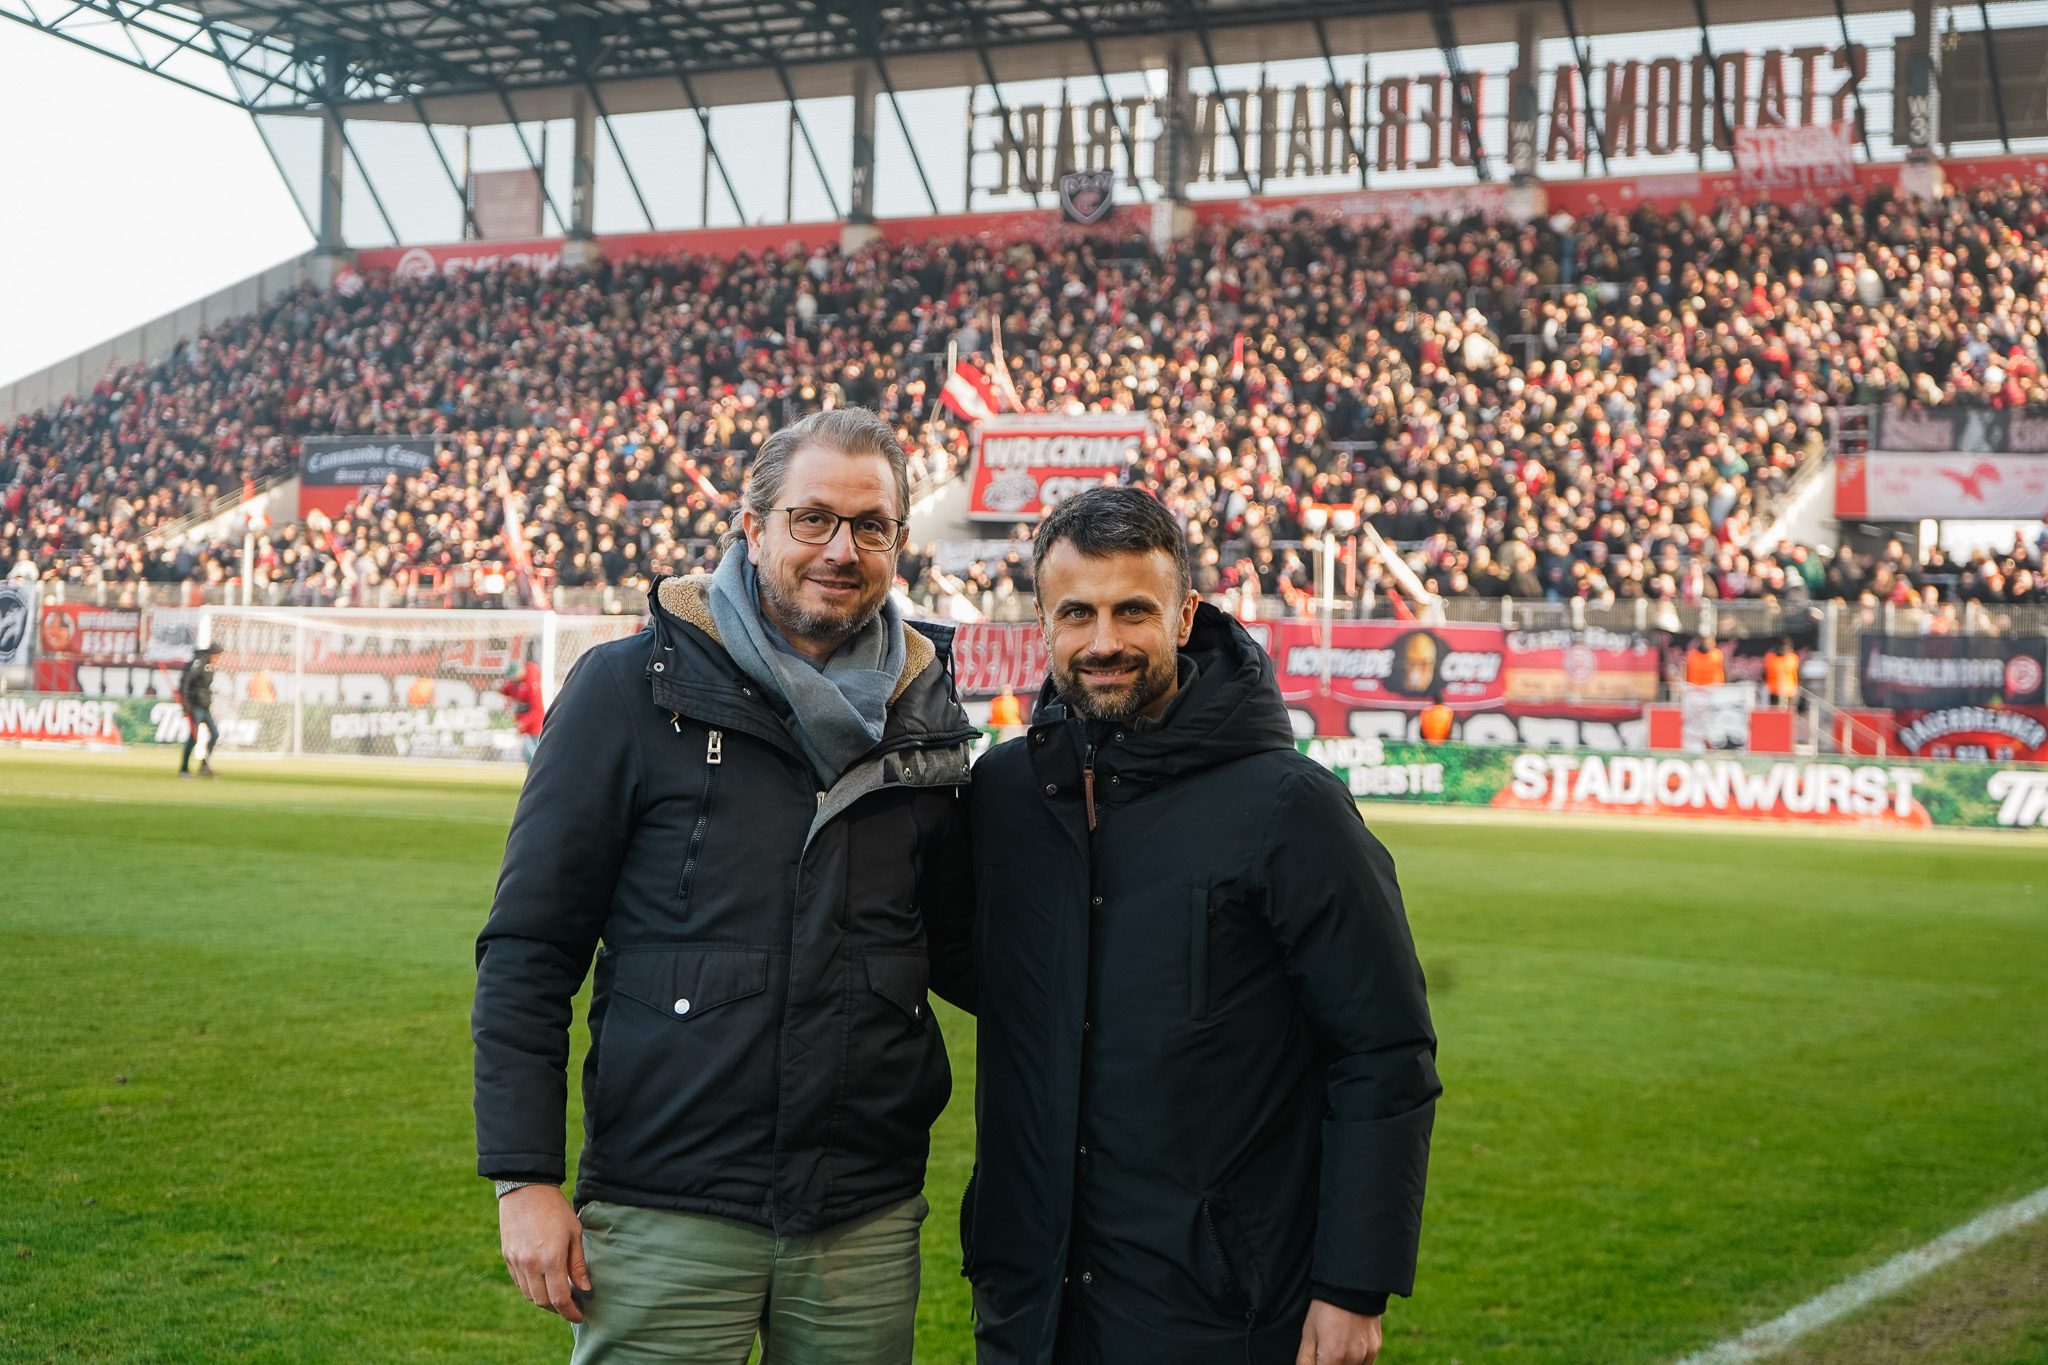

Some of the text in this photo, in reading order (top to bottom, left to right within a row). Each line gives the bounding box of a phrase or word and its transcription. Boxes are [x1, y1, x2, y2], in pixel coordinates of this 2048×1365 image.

[1305, 737, 1385, 768] ANDS
[1350, 763, 1444, 795] BESTE
[1512, 754, 1922, 817] STADIONWURST
